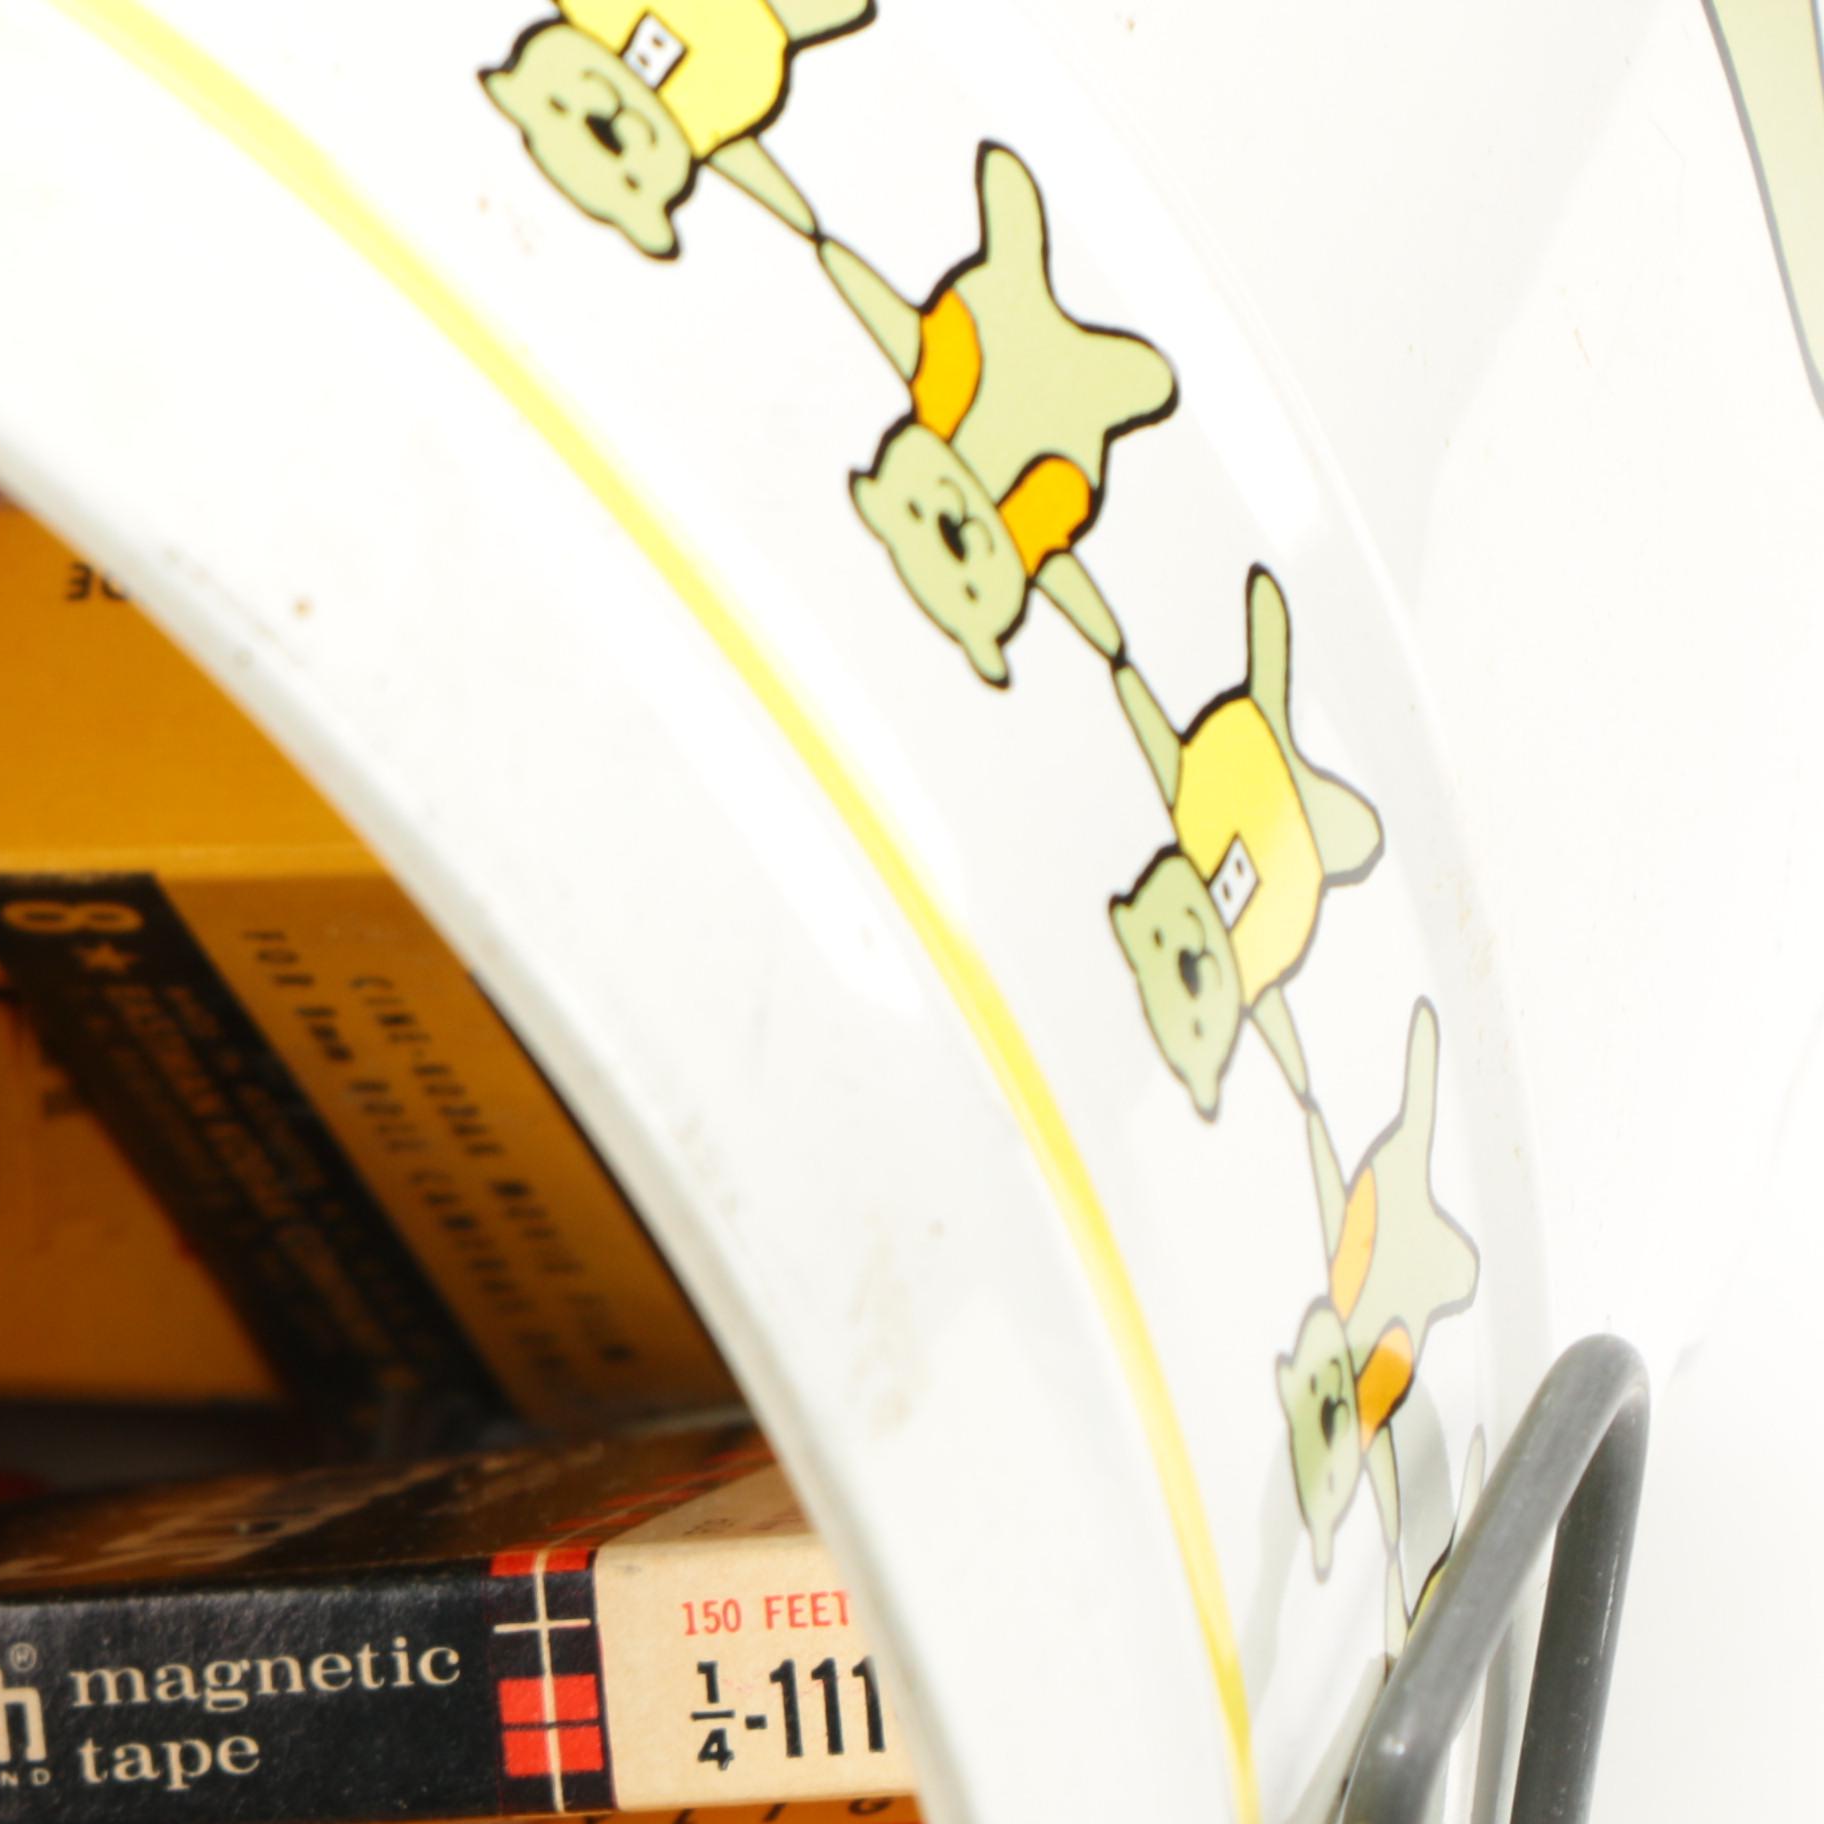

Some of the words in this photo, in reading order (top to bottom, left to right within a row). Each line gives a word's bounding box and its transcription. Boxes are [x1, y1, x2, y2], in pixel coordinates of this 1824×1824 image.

[681, 1598, 742, 1636] 150
[762, 1591, 848, 1630] FEET
[69, 1636, 460, 1712] magnetic
[78, 1735, 260, 1791] tape
